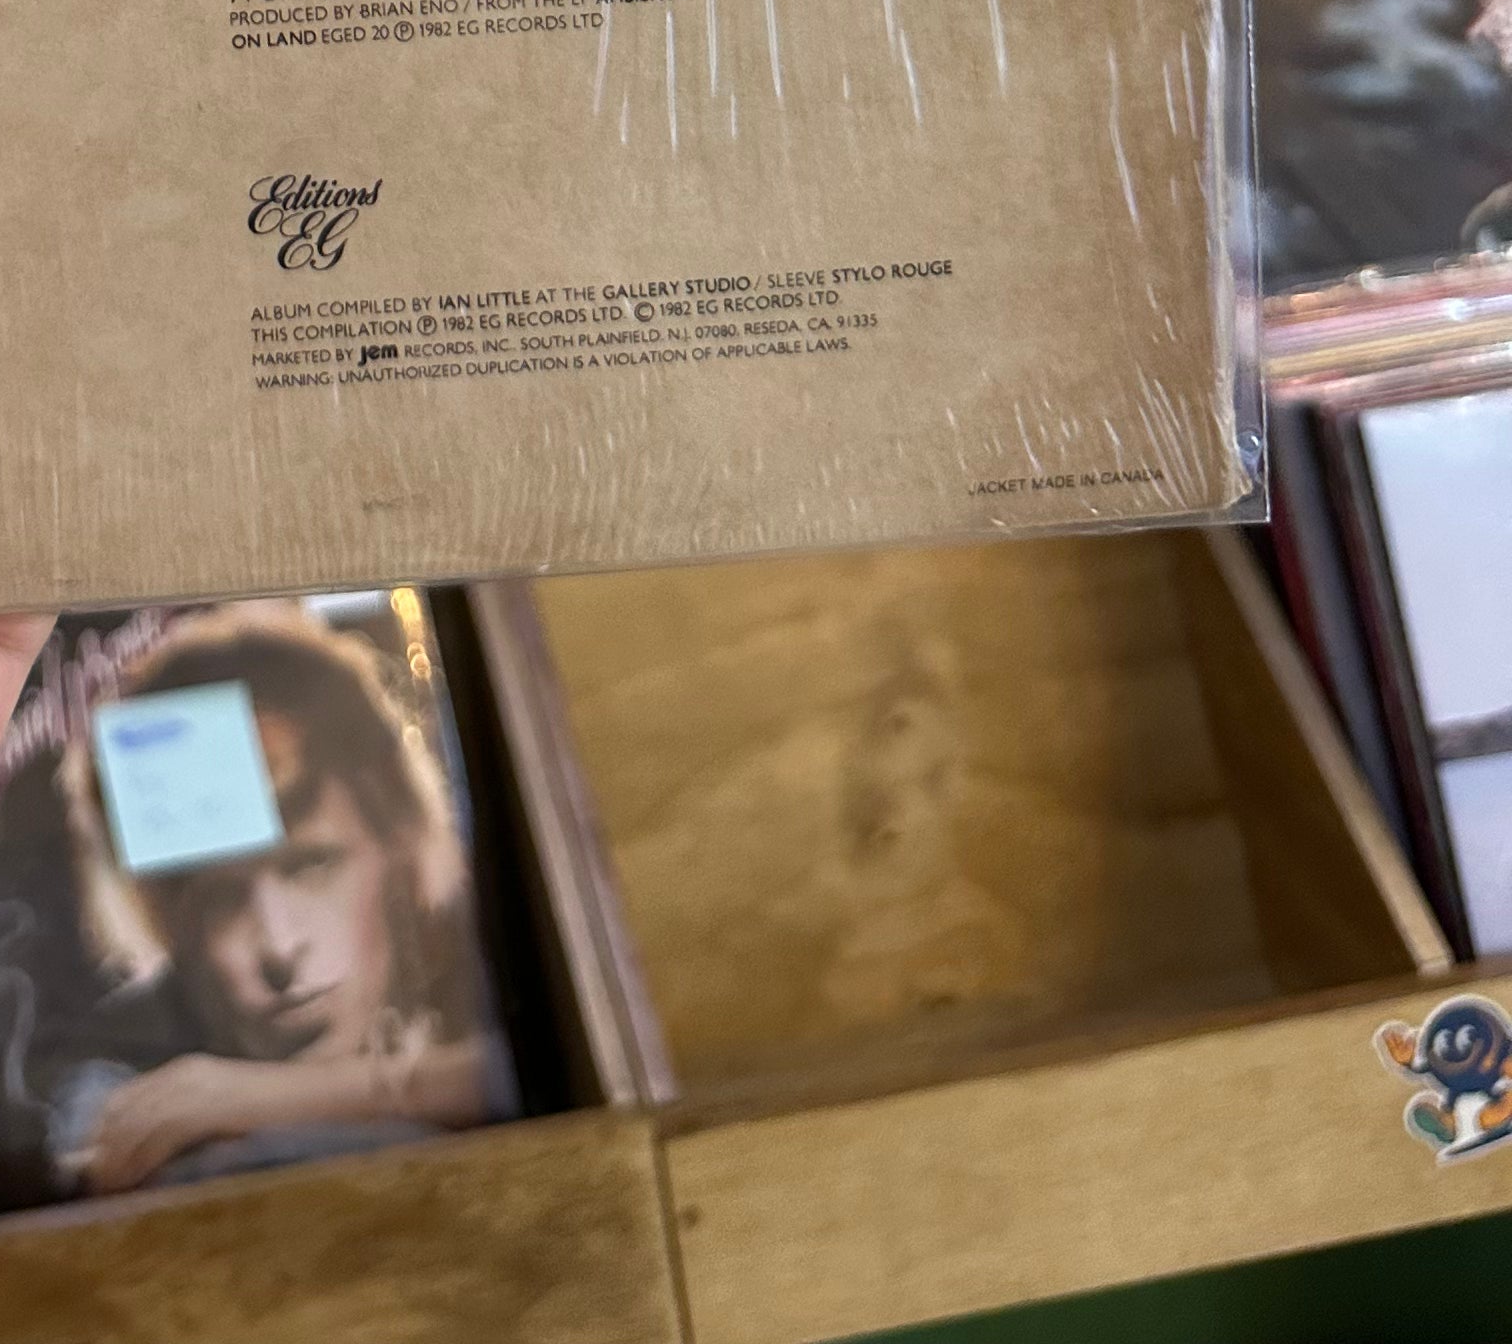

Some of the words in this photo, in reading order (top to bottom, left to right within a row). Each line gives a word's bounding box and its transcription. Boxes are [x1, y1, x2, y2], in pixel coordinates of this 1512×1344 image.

[247, 174, 383, 234] Editions
[277, 209, 359, 270] EG
[250, 301, 311, 322] ALBUM
[316, 294, 406, 318] COMPILED
[411, 292, 432, 312] BY
[438, 290, 471, 310] IAN
[476, 286, 530, 307] LITTLE
[534, 284, 557, 303] AT
[562, 281, 595, 302] THE
[601, 276, 679, 299] GALLERY
[684, 271, 751, 293] STUDIO
[767, 266, 824, 288] SLEEVE
[831, 262, 886, 284] STYLO
[891, 257, 954, 280] ROUGE
[1031, 473, 1075, 492] MADE
[1080, 471, 1096, 487] IN
